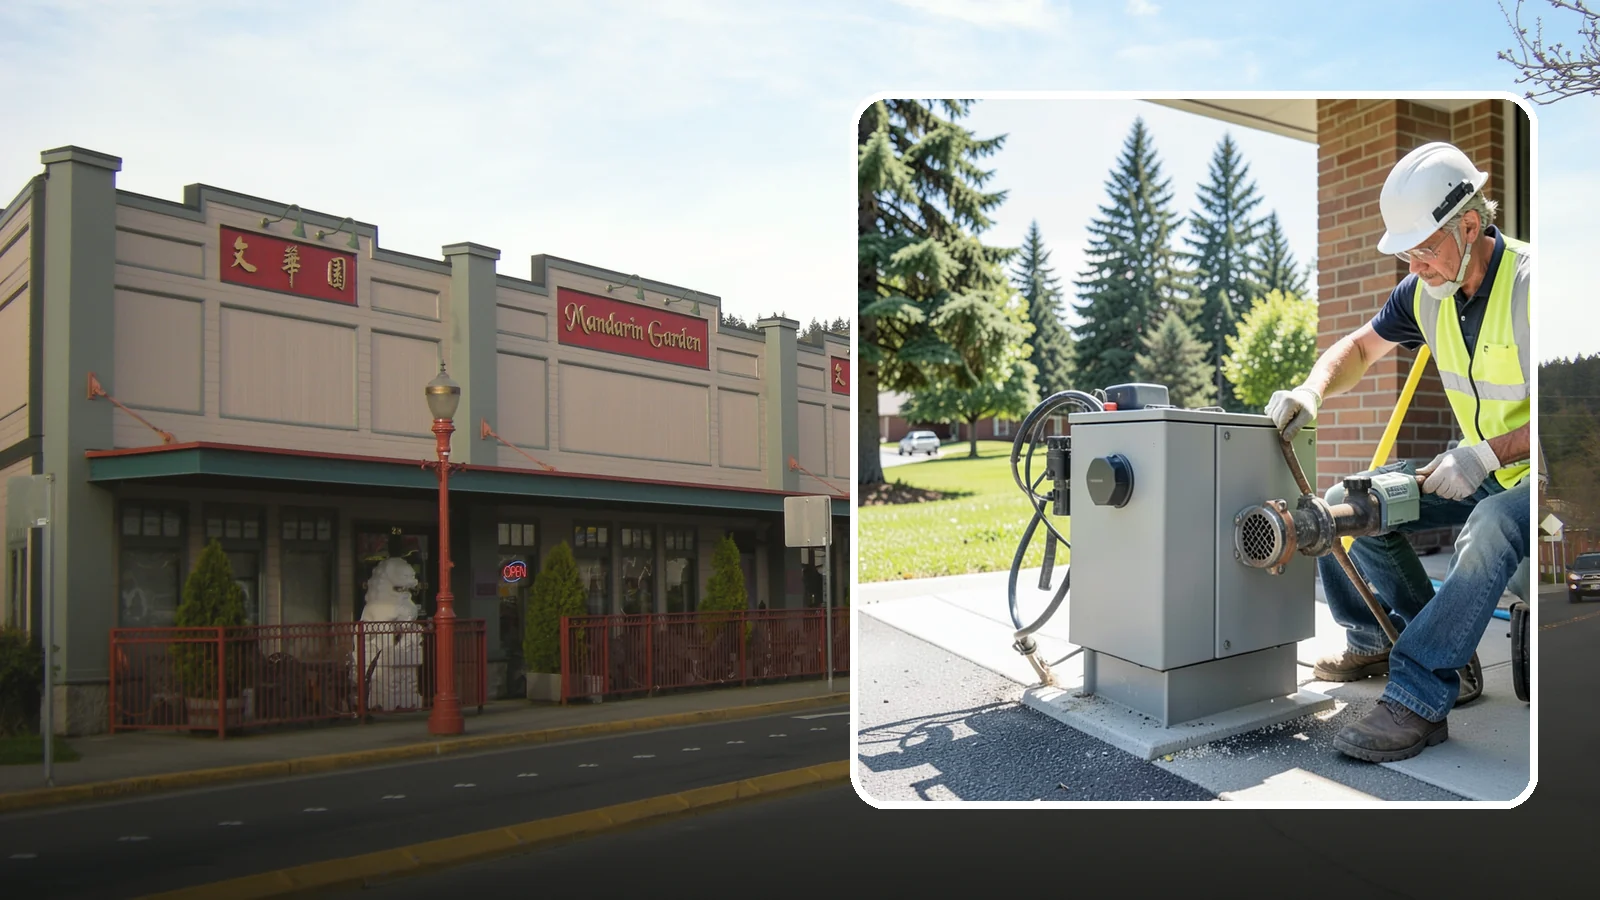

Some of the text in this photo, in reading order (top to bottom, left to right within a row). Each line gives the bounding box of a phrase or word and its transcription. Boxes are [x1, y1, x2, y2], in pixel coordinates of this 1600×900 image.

[231, 235, 346, 290] 文華園
[564, 302, 701, 352] Mandarin Garden
[834, 363, 847, 386] 文
[503, 565, 527, 578] OPEN
